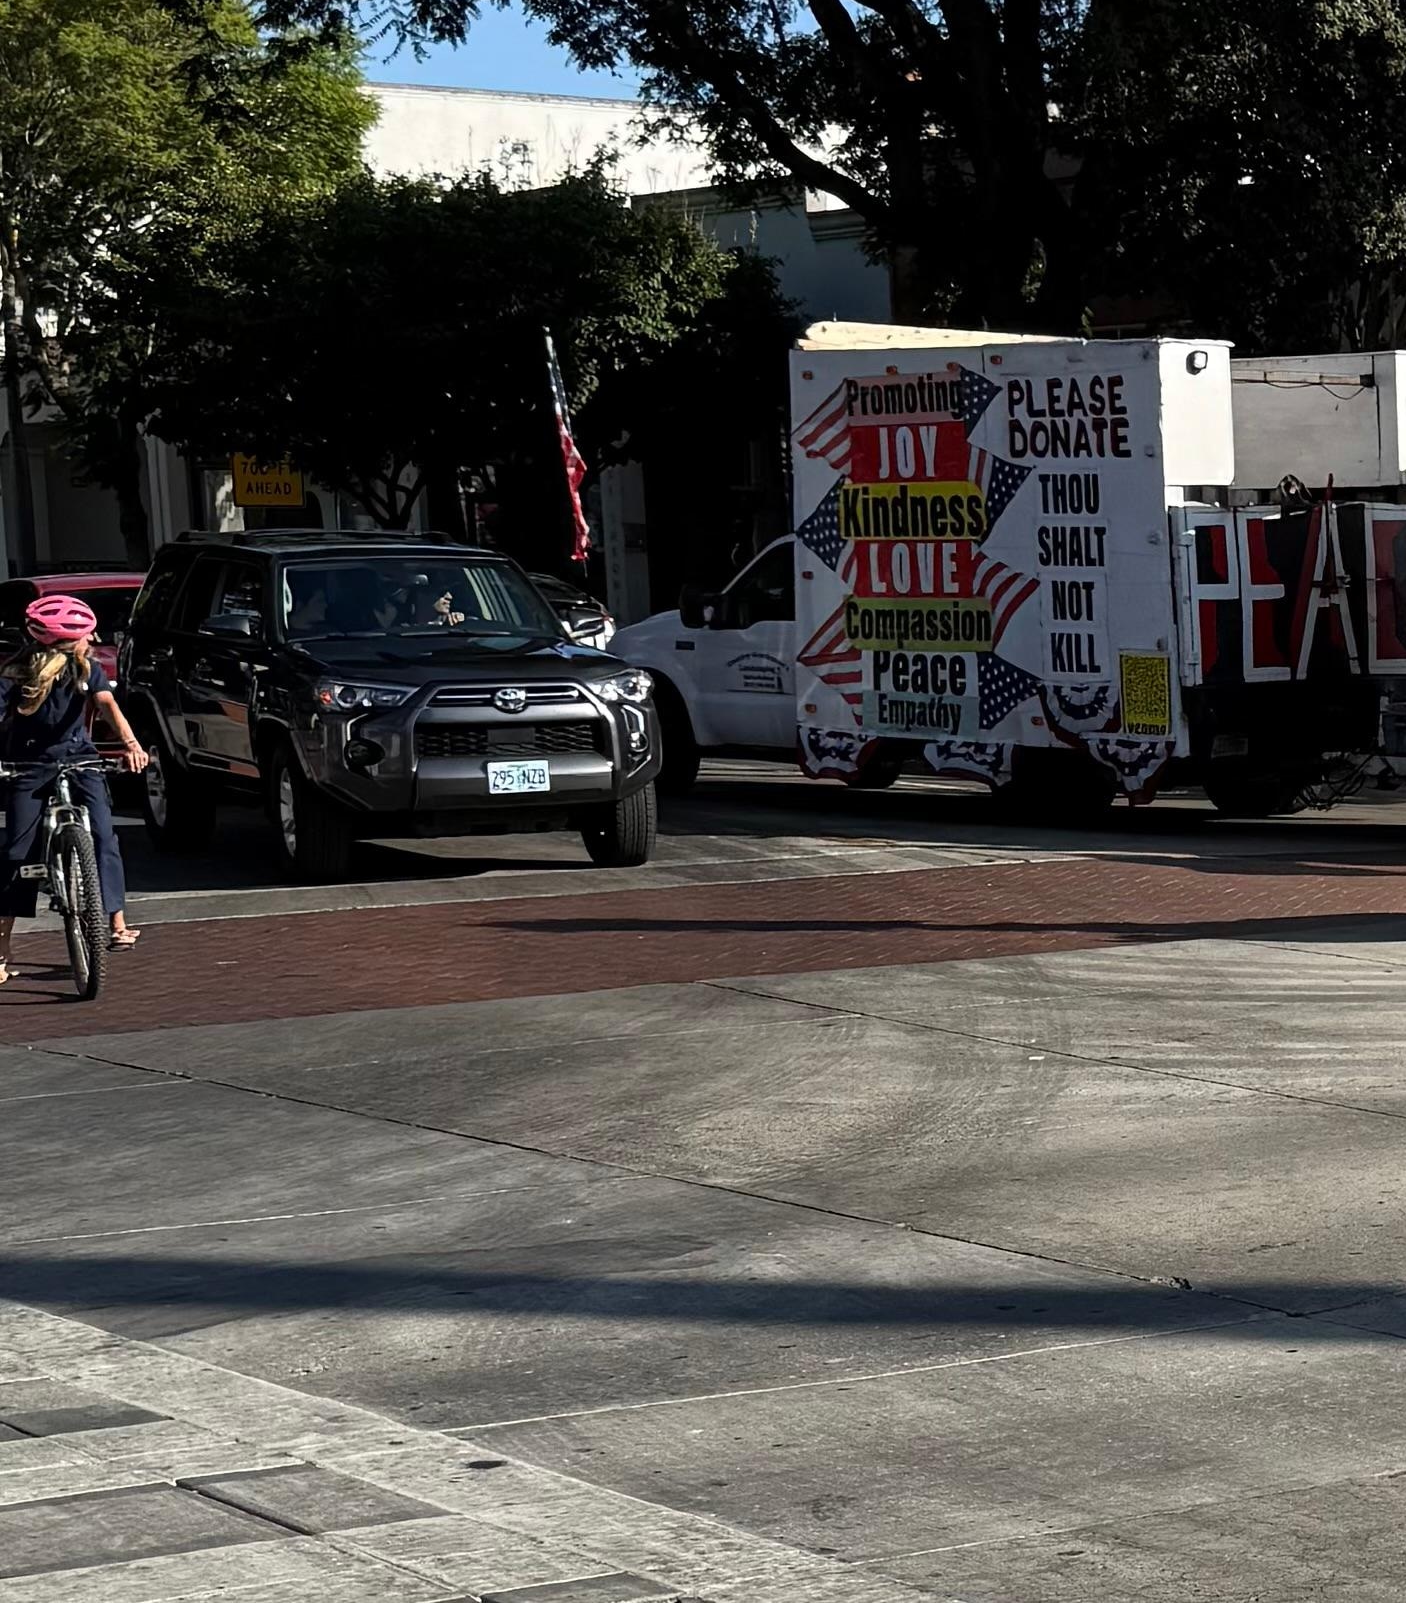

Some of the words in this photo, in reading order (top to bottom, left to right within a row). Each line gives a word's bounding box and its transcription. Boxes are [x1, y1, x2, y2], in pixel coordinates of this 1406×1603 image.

[847, 374, 966, 420] Promoting
[1008, 375, 1128, 419] PLEASE
[879, 426, 938, 479] JOY
[1009, 417, 1132, 459] DONATE
[246, 481, 292, 495] AHEAD
[1039, 473, 1100, 515] THOU
[843, 484, 985, 539] Kindness
[869, 542, 960, 594] LOVE
[1038, 526, 1107, 567] SHALT
[1051, 580, 1095, 621] NOT
[846, 600, 992, 648] Compassion
[873, 651, 967, 696] Peace
[1051, 633, 1100, 673] KILL
[878, 695, 962, 735] Empathy
